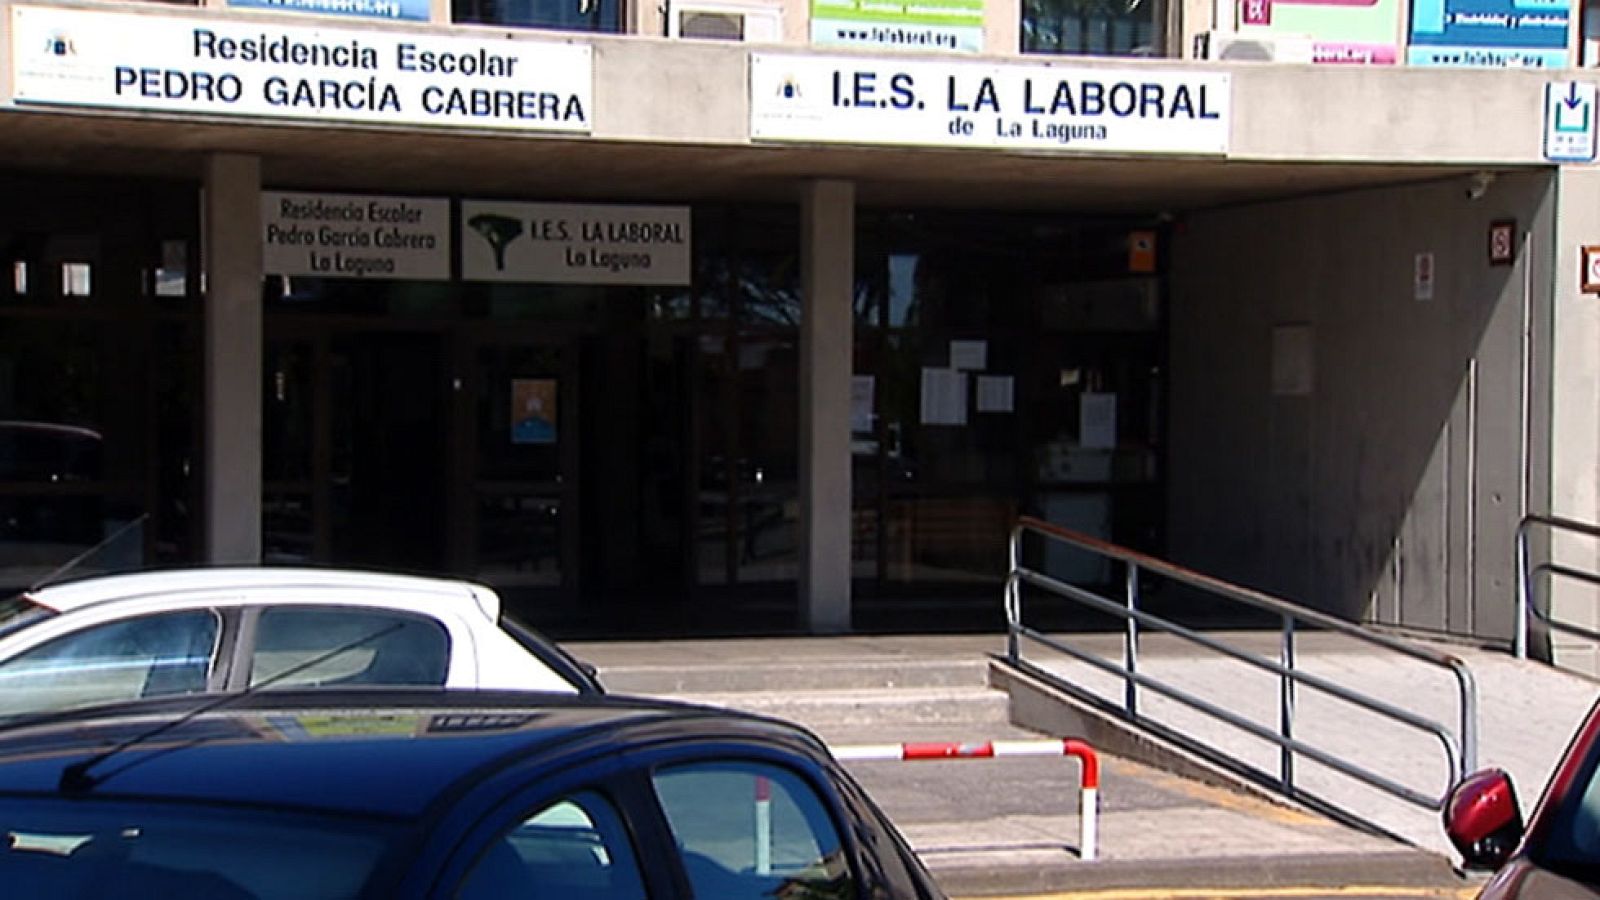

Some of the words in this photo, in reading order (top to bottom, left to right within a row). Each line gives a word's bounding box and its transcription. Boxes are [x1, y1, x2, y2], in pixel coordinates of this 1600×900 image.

[193, 29, 378, 69] Residencia
[397, 44, 519, 78] Escolar
[115, 67, 243, 102] PEDRO
[263, 76, 401, 112] GARCÍA
[422, 86, 585, 122] CABRERA
[832, 70, 925, 110] I.E.S.
[947, 76, 1000, 113] LA
[1024, 79, 1220, 120] LABORAL
[948, 117, 974, 135] de
[997, 118, 1022, 137] La
[1032, 120, 1107, 143] Laguna
[280, 199, 364, 221] Residencia
[369, 202, 422, 222] Escolar
[267, 224, 315, 246] Pedro
[319, 225, 370, 247] García
[374, 227, 436, 249] Cabrera
[531, 220, 573, 241] I.E.S.
[582, 221, 603, 242] LA
[608, 222, 684, 244] LABORAL
[310, 252, 331, 271] La
[335, 252, 395, 276] Laguna
[565, 249, 587, 266] La
[591, 249, 651, 272] Laguna
